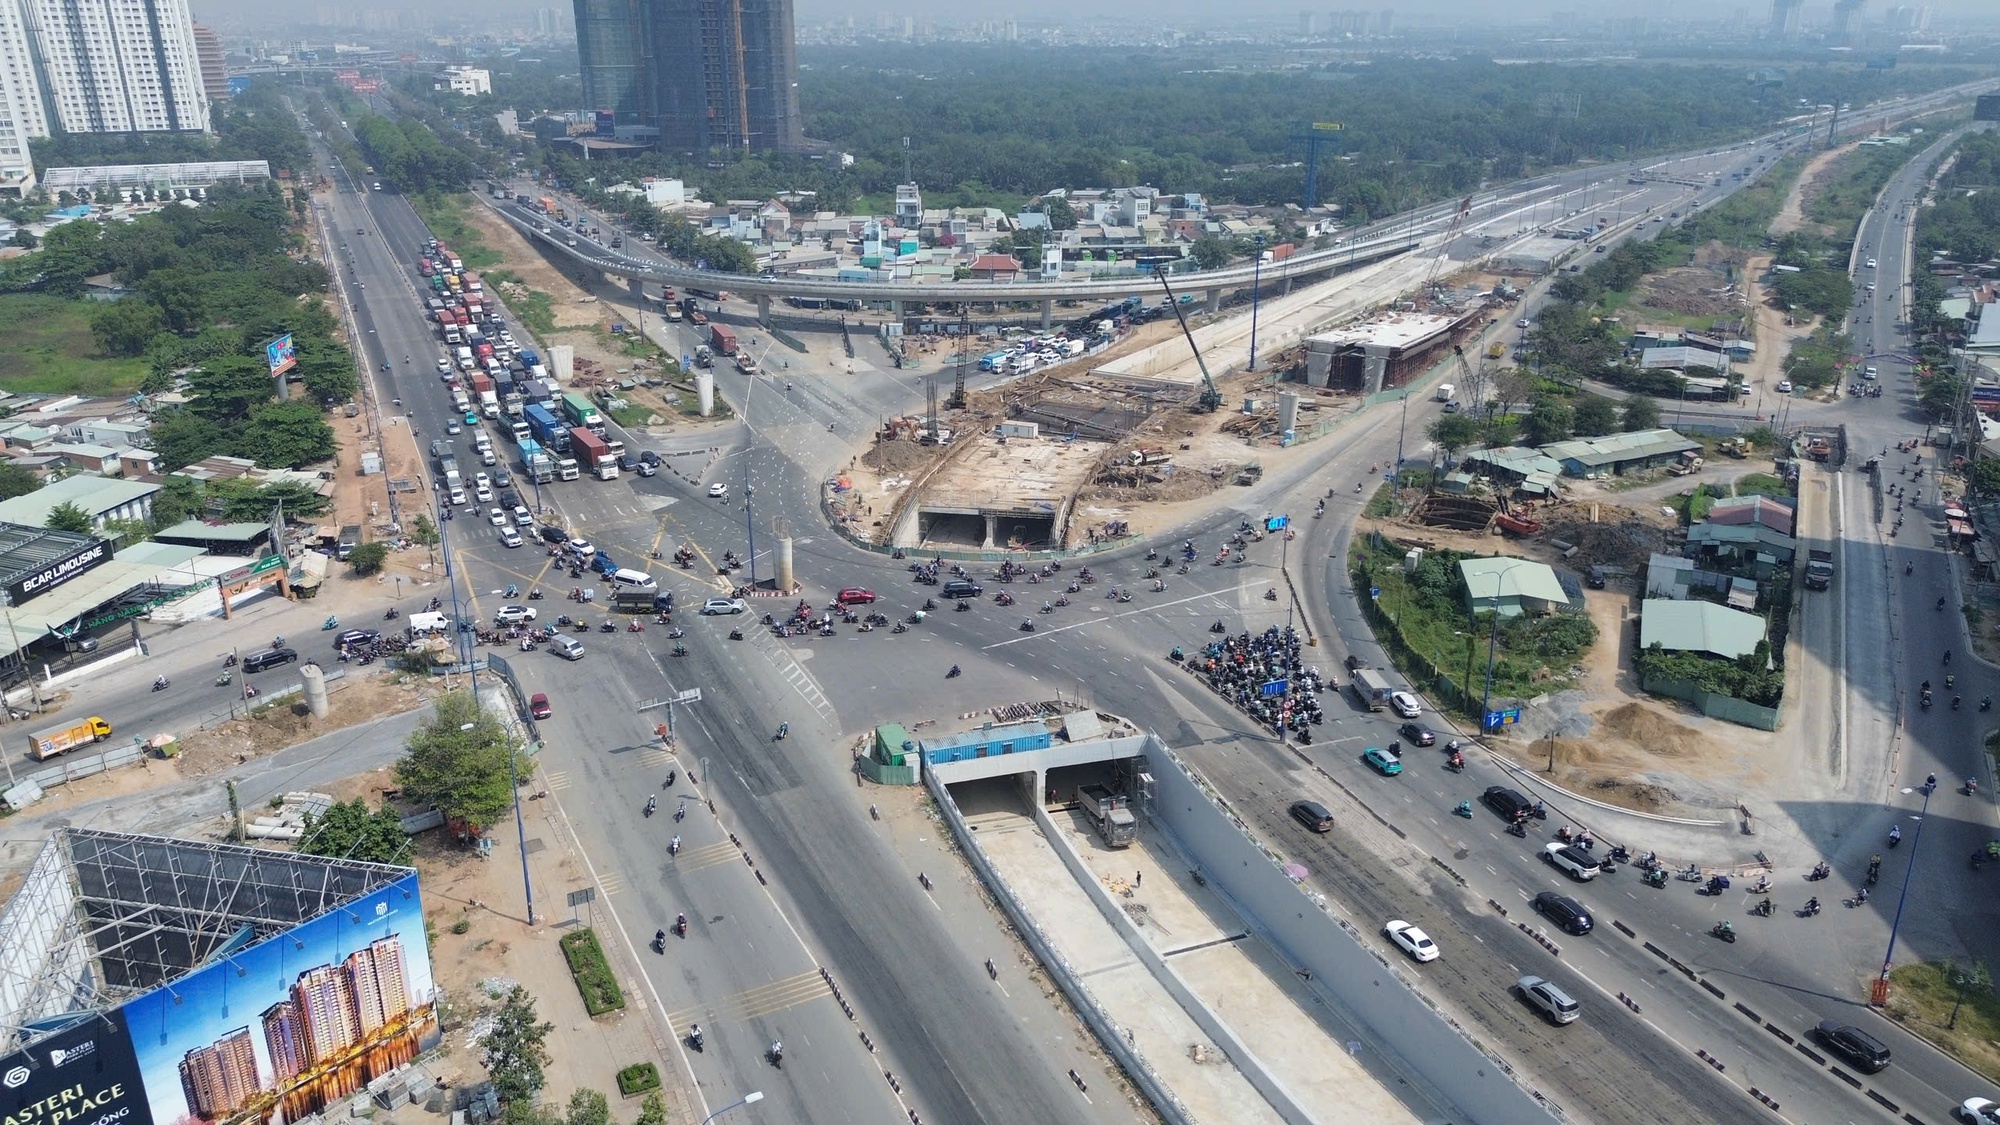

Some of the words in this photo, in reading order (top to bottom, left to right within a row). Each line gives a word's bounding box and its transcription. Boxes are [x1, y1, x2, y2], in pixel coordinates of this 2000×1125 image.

[23, 571, 53, 592] BCAR
[53, 546, 103, 577] LIMOUSINE
[67, 567, 84, 578] UPGRADE
[230, 569, 250, 579] Castrol
[51, 1083, 125, 1125] PLACE
